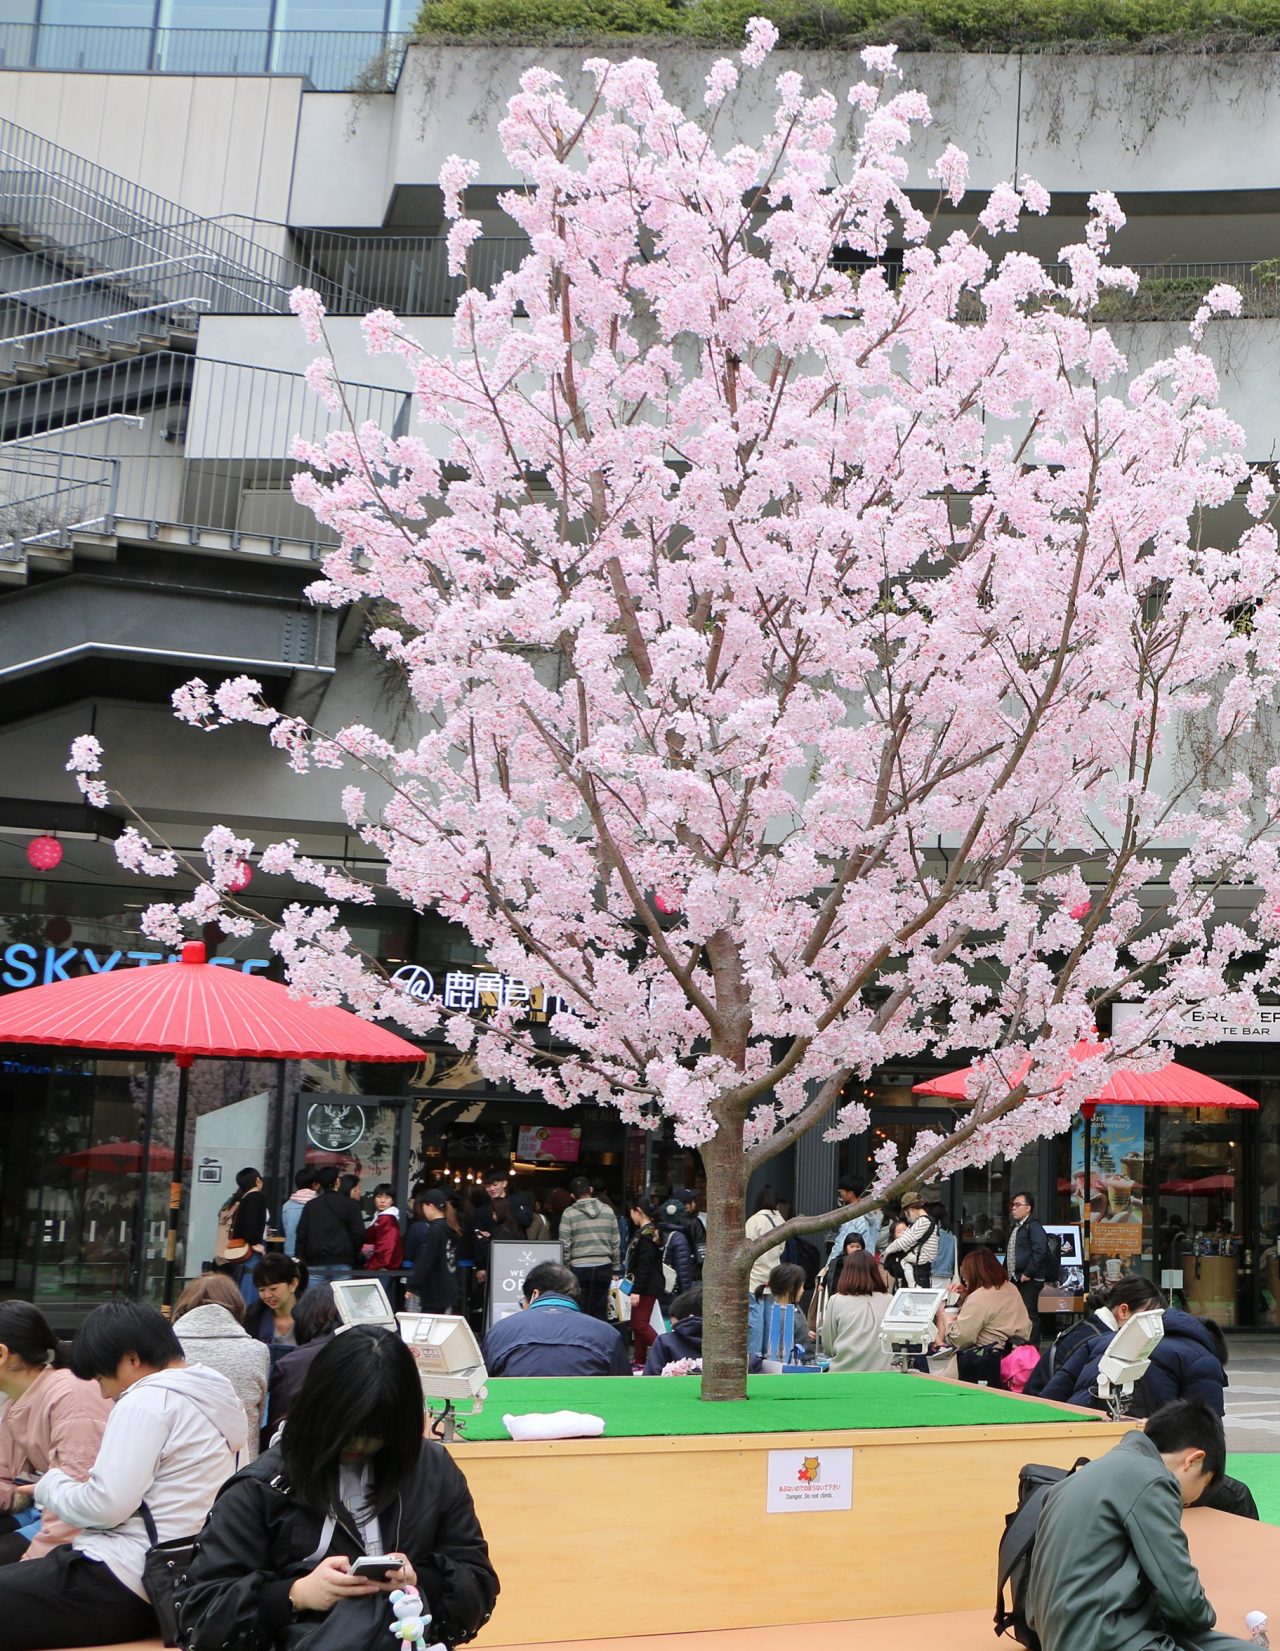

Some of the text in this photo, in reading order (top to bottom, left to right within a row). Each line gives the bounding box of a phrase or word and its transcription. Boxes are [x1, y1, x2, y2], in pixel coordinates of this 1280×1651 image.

[2, 943, 270, 988] SKYT
[1242, 1027, 1270, 1036] BAR
[510, 1269, 525, 1277] WE
[502, 1278, 525, 1292] OP
